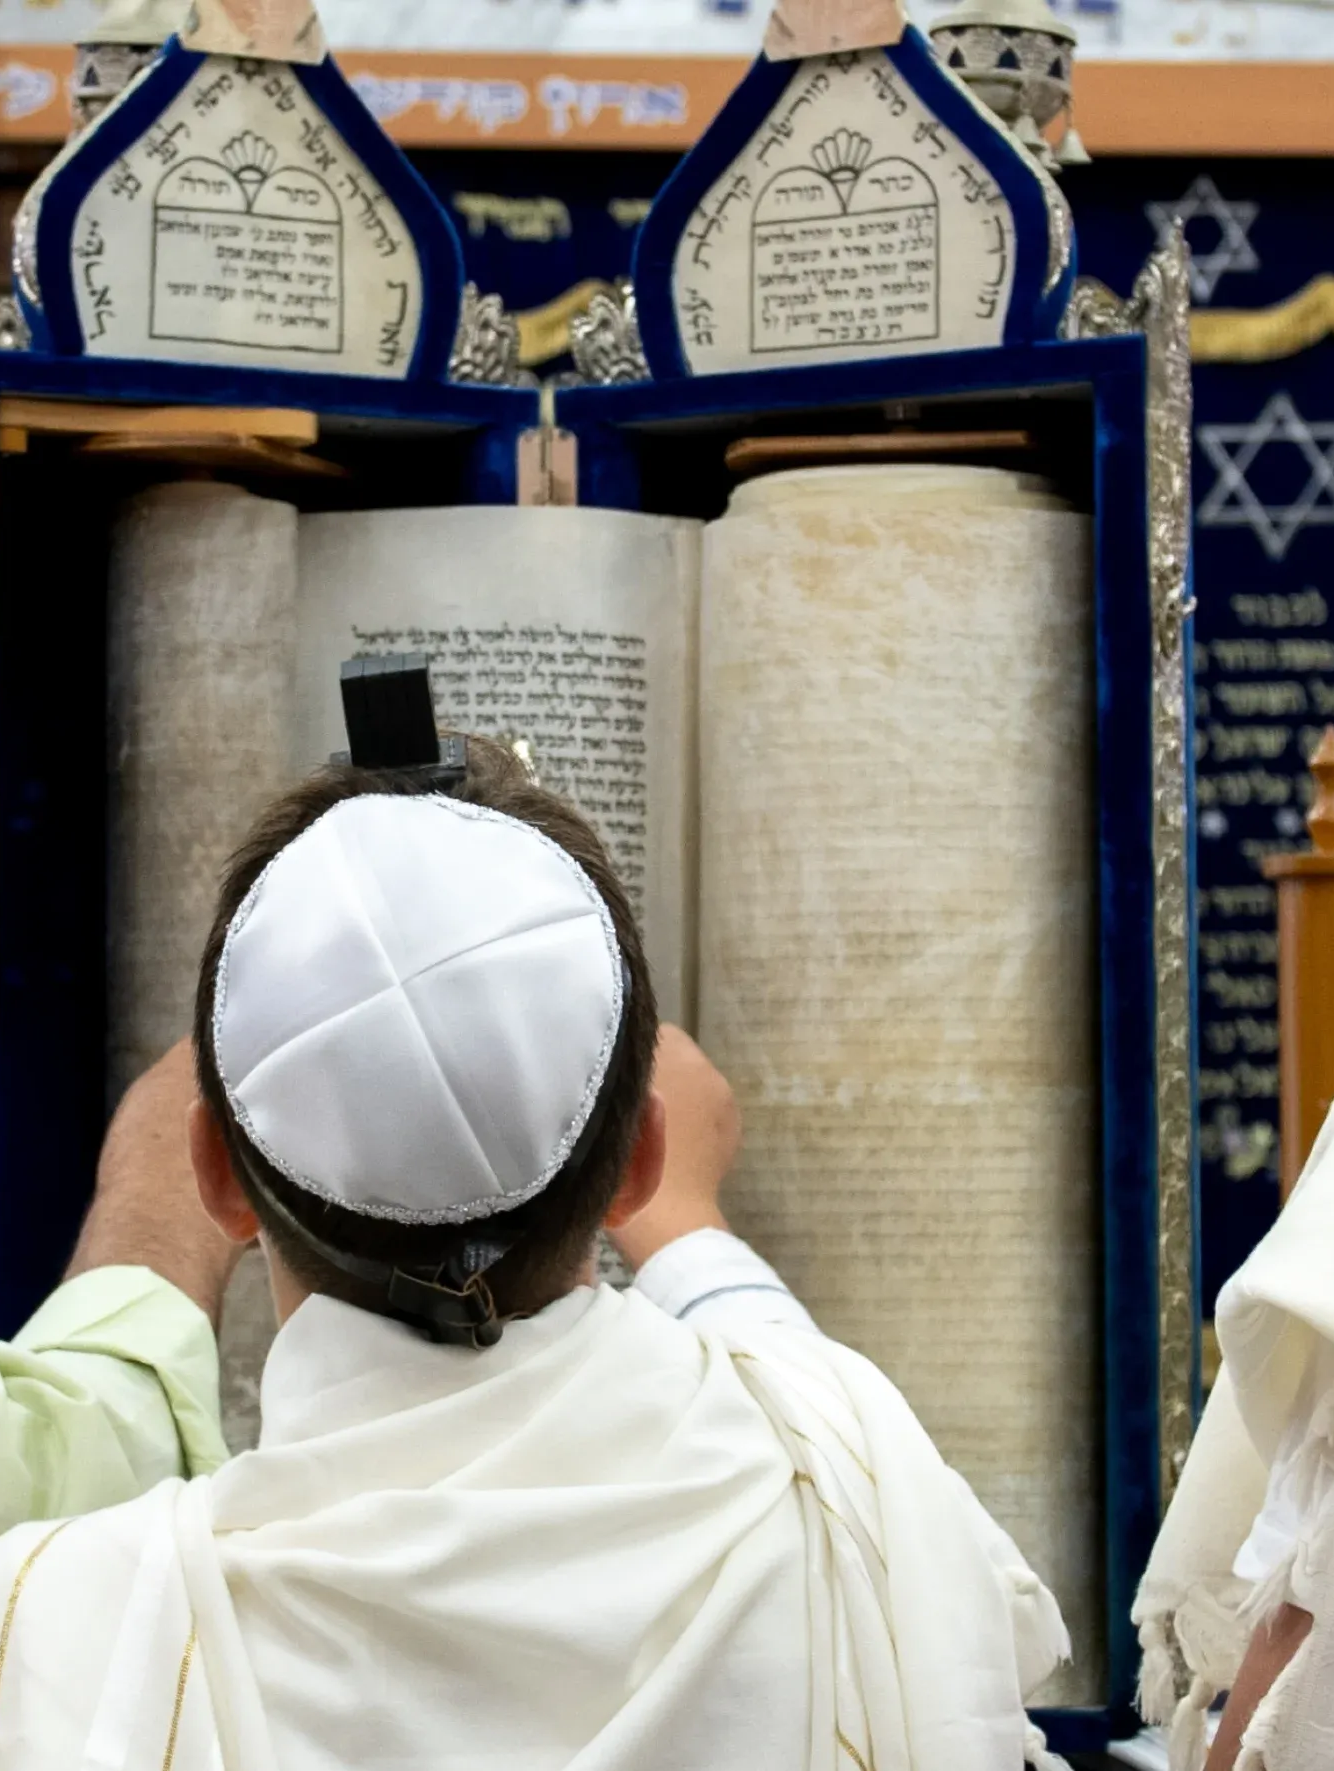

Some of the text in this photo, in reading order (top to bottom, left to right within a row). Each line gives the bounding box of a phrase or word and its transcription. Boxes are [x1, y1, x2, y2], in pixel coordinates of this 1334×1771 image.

[264, 76, 295, 112] שם
[300, 117, 336, 171] אשר
[177, 171, 321, 206] כתר תורה
[774, 174, 914, 206] כתר תורה
[337, 172, 402, 258] התורה
